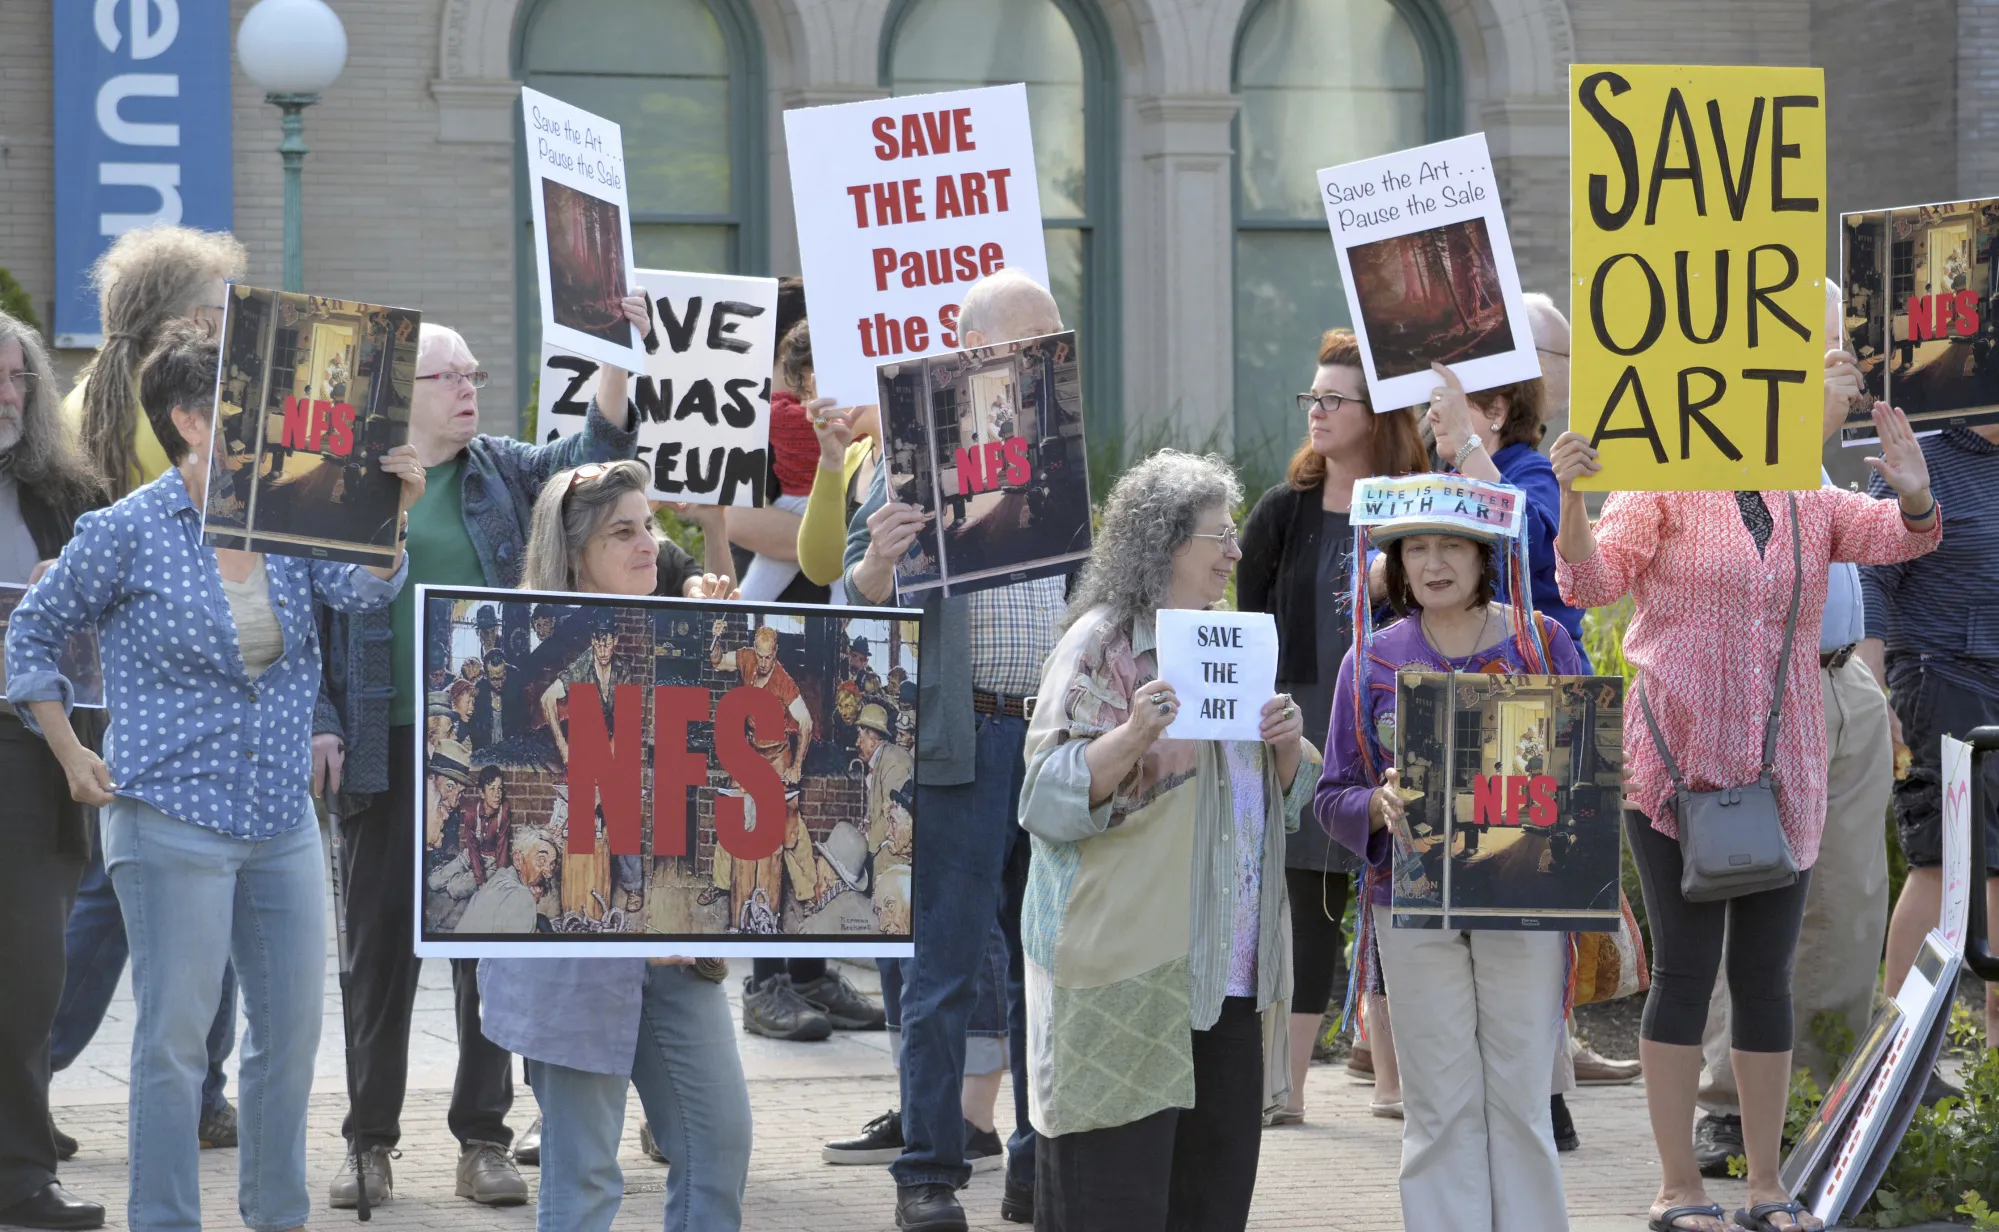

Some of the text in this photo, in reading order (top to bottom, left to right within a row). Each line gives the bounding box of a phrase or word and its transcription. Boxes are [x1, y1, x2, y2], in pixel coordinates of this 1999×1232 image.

[532, 105, 561, 137] Save
[564, 119, 582, 145] the
[585, 127, 603, 154] Art
[871, 107, 977, 162] SAVE
[1578, 71, 1819, 231] SAVE
[538, 136, 622, 190] Pause the Sale
[1326, 182, 1376, 205] Save
[1381, 170, 1412, 193] the
[1419, 160, 1450, 185] Art
[846, 168, 1012, 229] THE ART
[1338, 181, 1486, 232] Pause the Sale
[872, 242, 1005, 292] Pause
[644, 291, 766, 355] VE
[1589, 243, 1812, 356] OUR
[1907, 289, 1980, 342] NFS
[857, 312, 930, 358] the
[281, 395, 357, 457] NFS
[1589, 365, 1808, 466] ART
[955, 436, 1032, 496] NFS
[1365, 496, 1434, 516] WITH
[1367, 486, 1509, 508] LIFE IS BETTER
[1197, 625, 1243, 648] SAVE
[1201, 661, 1239, 684] THE
[1199, 698, 1238, 720] ART
[567, 682, 787, 861] NFS
[1473, 775, 1558, 827] NFS
